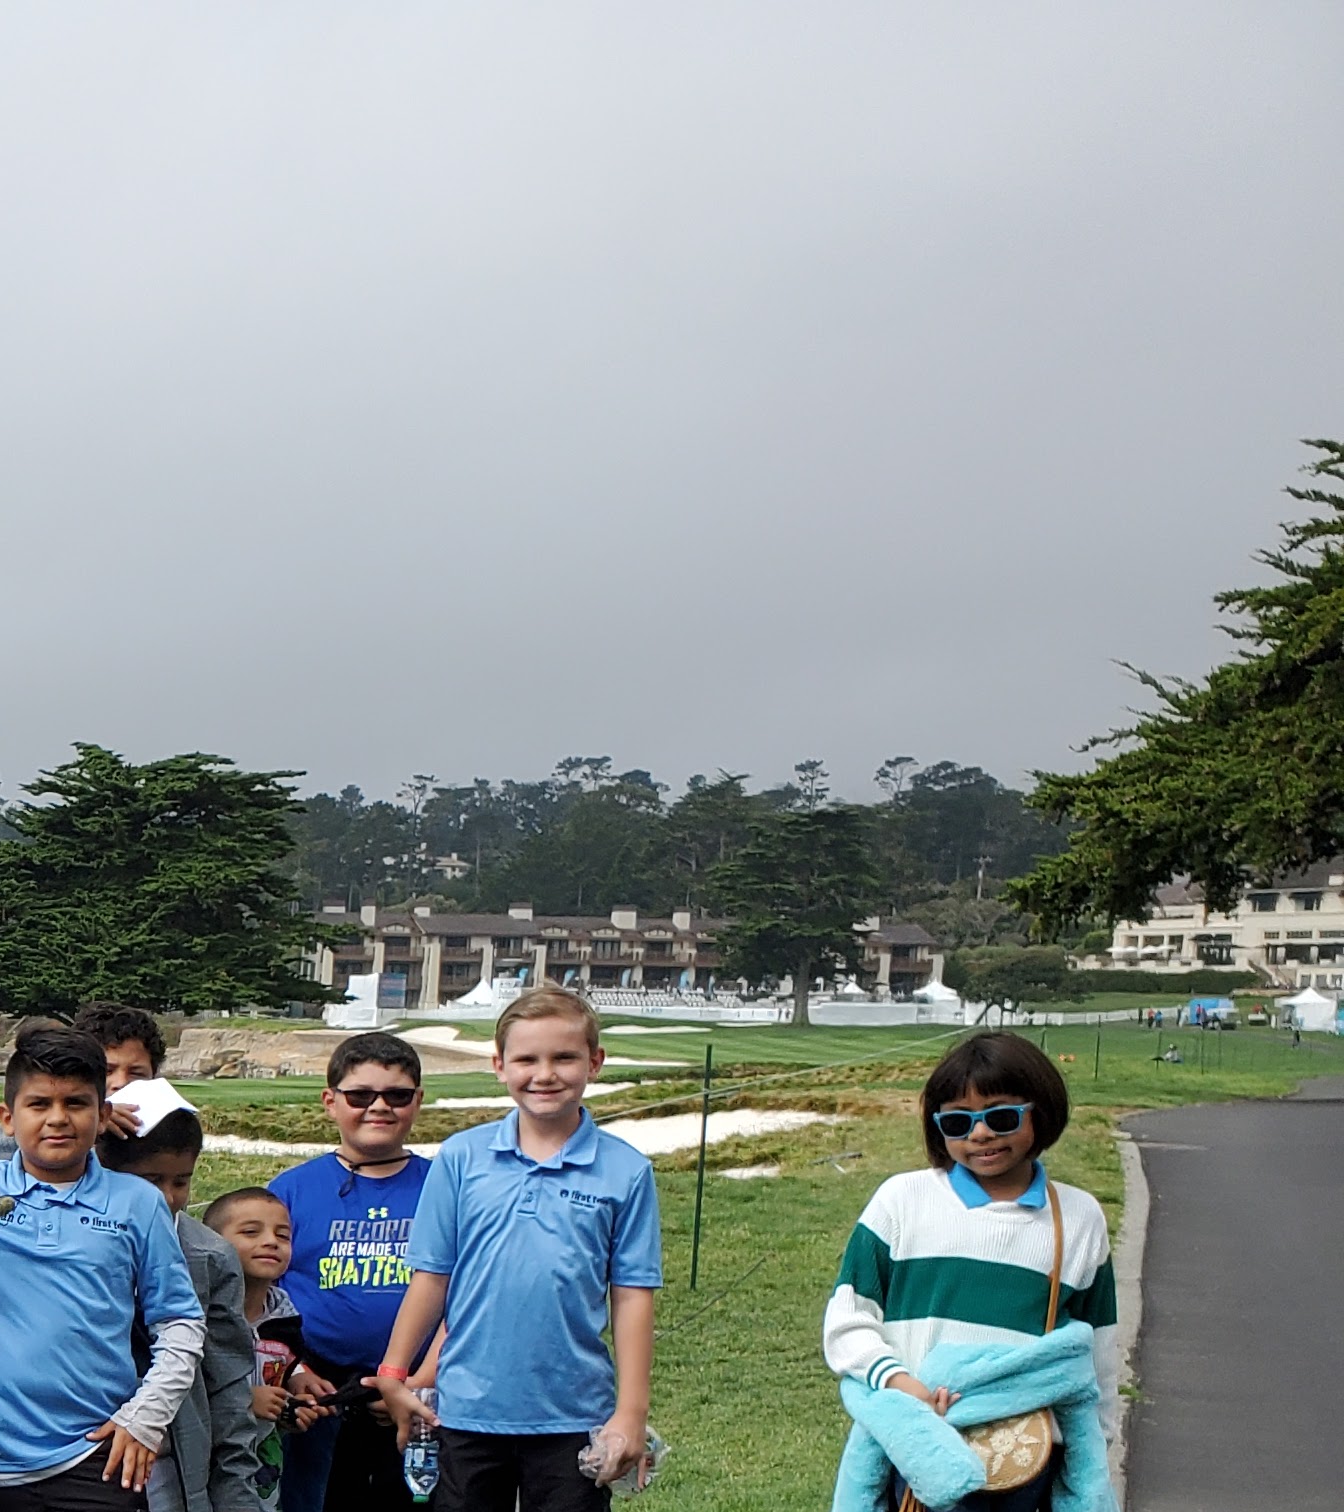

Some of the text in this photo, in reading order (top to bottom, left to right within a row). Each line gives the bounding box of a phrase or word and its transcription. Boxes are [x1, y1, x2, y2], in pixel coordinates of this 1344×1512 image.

[92, 1217, 111, 1228] first
[328, 1242, 357, 1257] ARE
[356, 1241, 392, 1257] MADE
